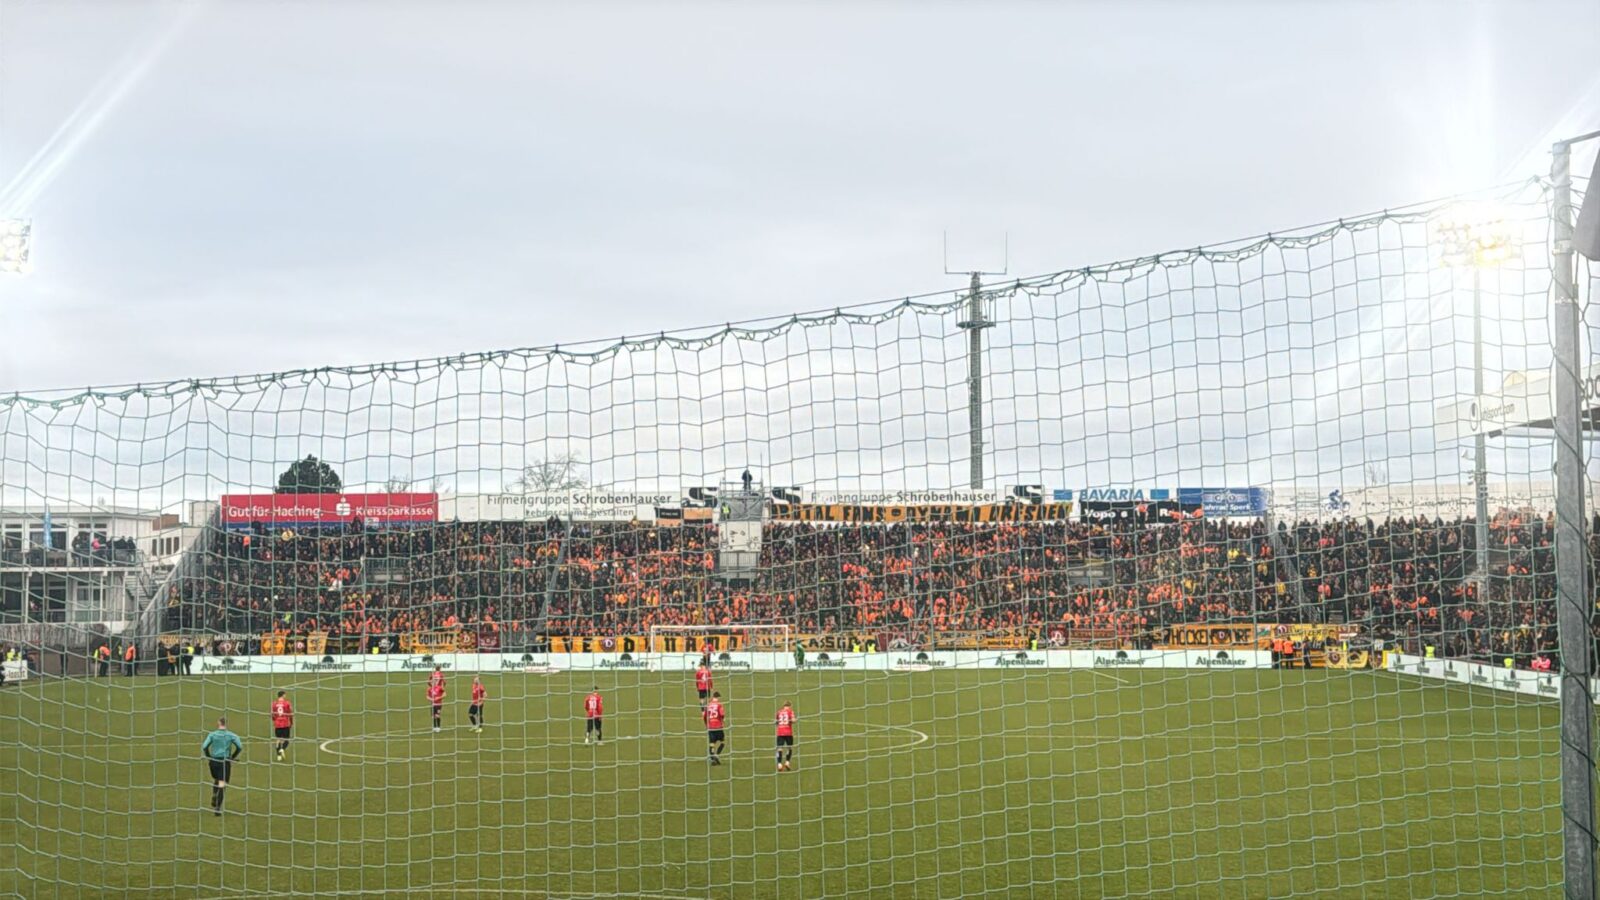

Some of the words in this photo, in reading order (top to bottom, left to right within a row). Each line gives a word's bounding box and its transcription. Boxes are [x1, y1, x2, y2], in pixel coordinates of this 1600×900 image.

[488, 494, 569, 507] Firmengruppe
[573, 493, 672, 505] Schrobenhauser
[811, 492, 892, 504] Fmengruppe
[897, 491, 996, 502] Schrobenhauser
[1079, 489, 1144, 500] BAVARIA
[228, 506, 247, 517] Gut
[250, 505, 269, 517] für
[355, 505, 433, 517] Kreissparkasse
[302, 661, 352, 671] Alpenbauer
[401, 659, 451, 671] Alpenbauer
[599, 659, 649, 670] Alpenbauer
[804, 659, 847, 669] lpenbauer
[995, 657, 1045, 667] Alpenbauer
[1095, 656, 1145, 666] Alpenbauer
[1196, 656, 1247, 667] Alpenbauer
[201, 662, 251, 672] Alpenbauer
